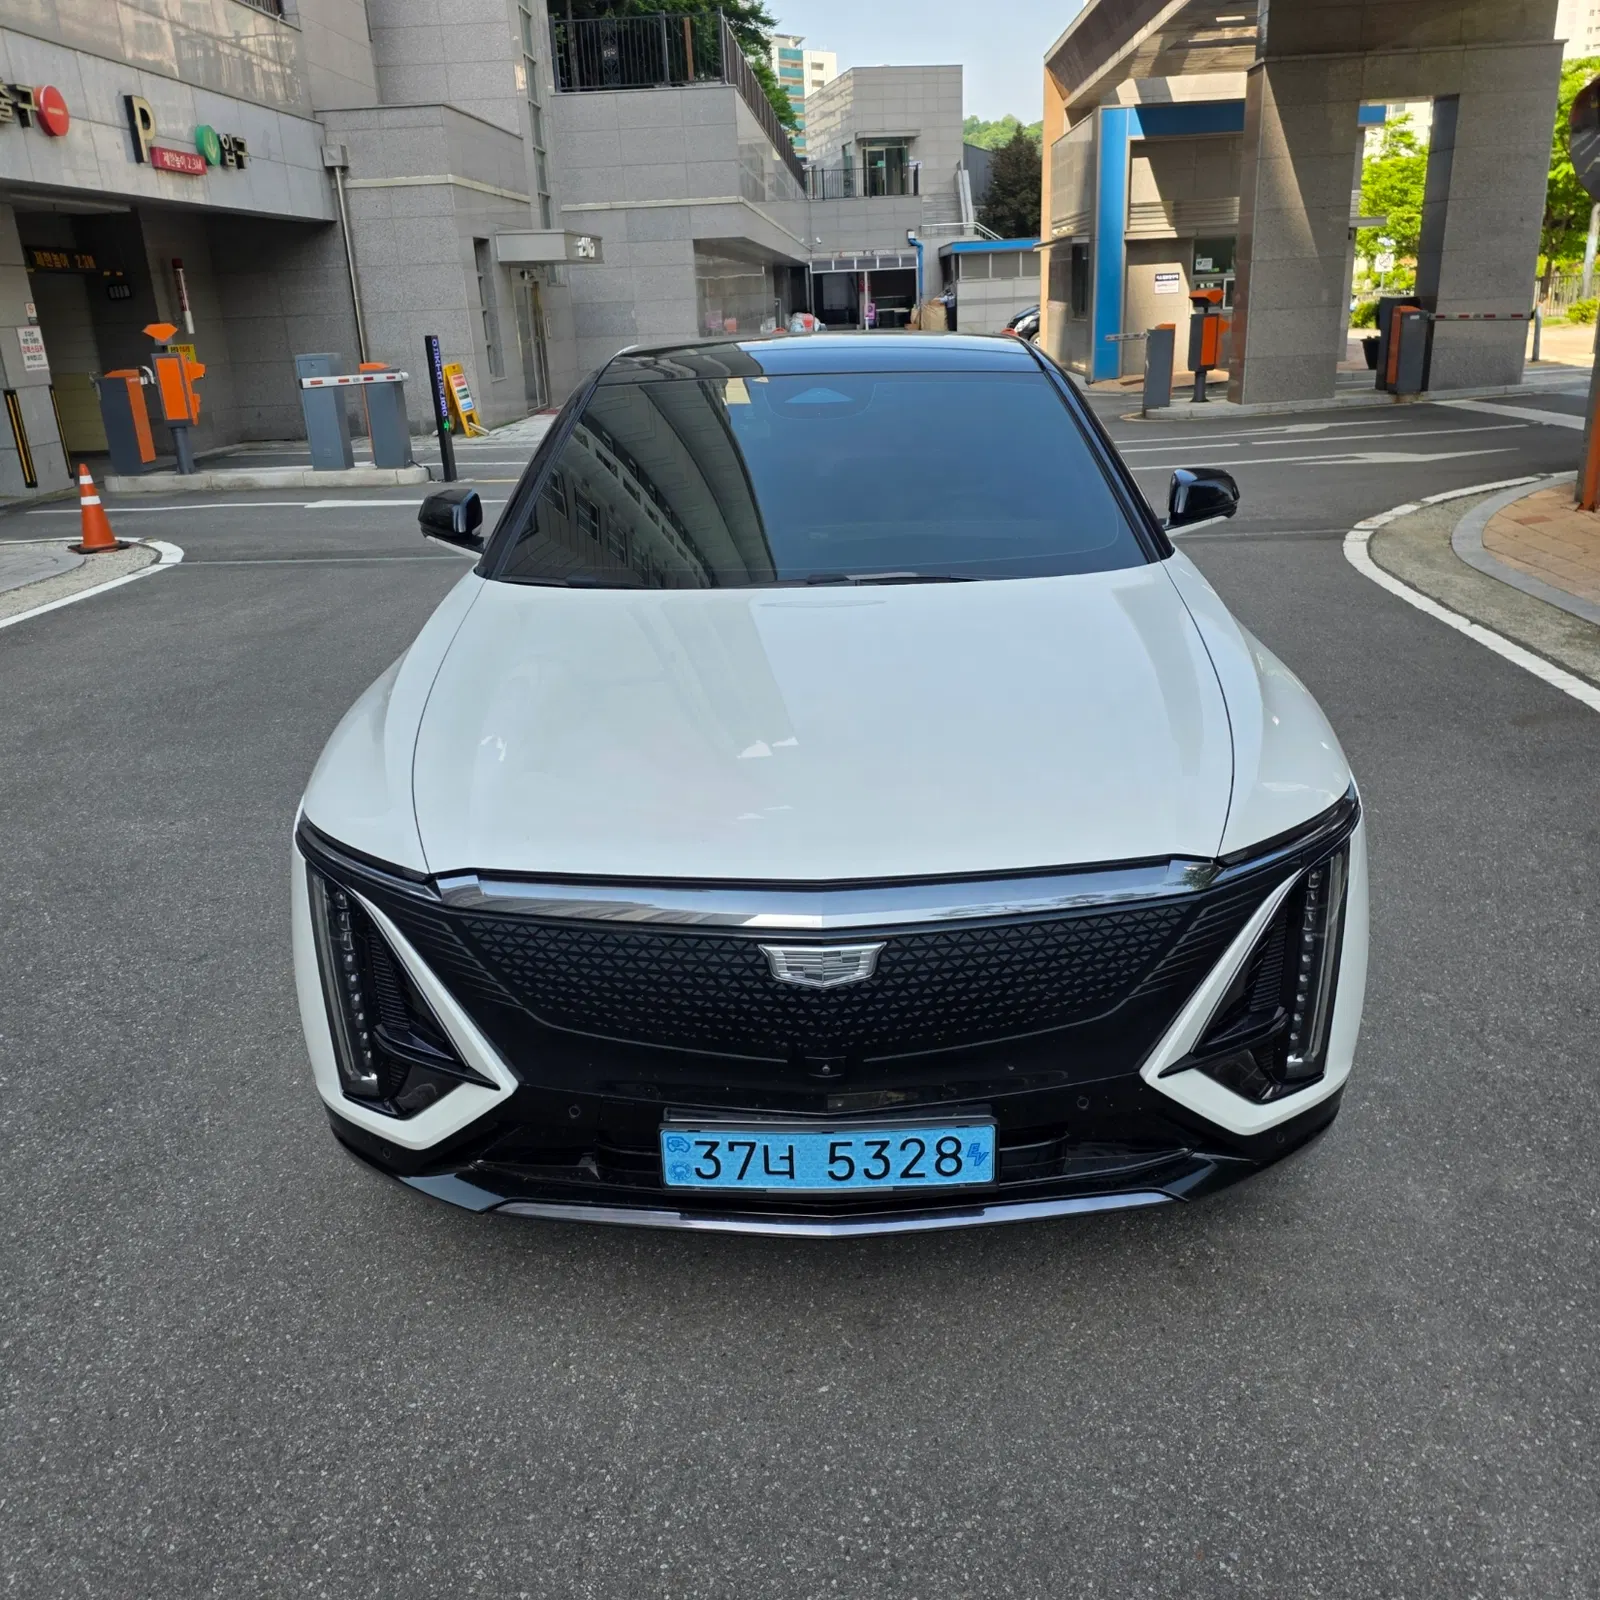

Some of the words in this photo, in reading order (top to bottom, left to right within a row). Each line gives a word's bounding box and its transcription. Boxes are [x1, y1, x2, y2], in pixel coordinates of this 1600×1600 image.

[125, 95, 156, 163] P
[219, 133, 249, 169] 입구
[694, 1140, 795, 1180] 37너
[827, 1136, 963, 1181] 5328
[966, 1142, 989, 1167] EV
